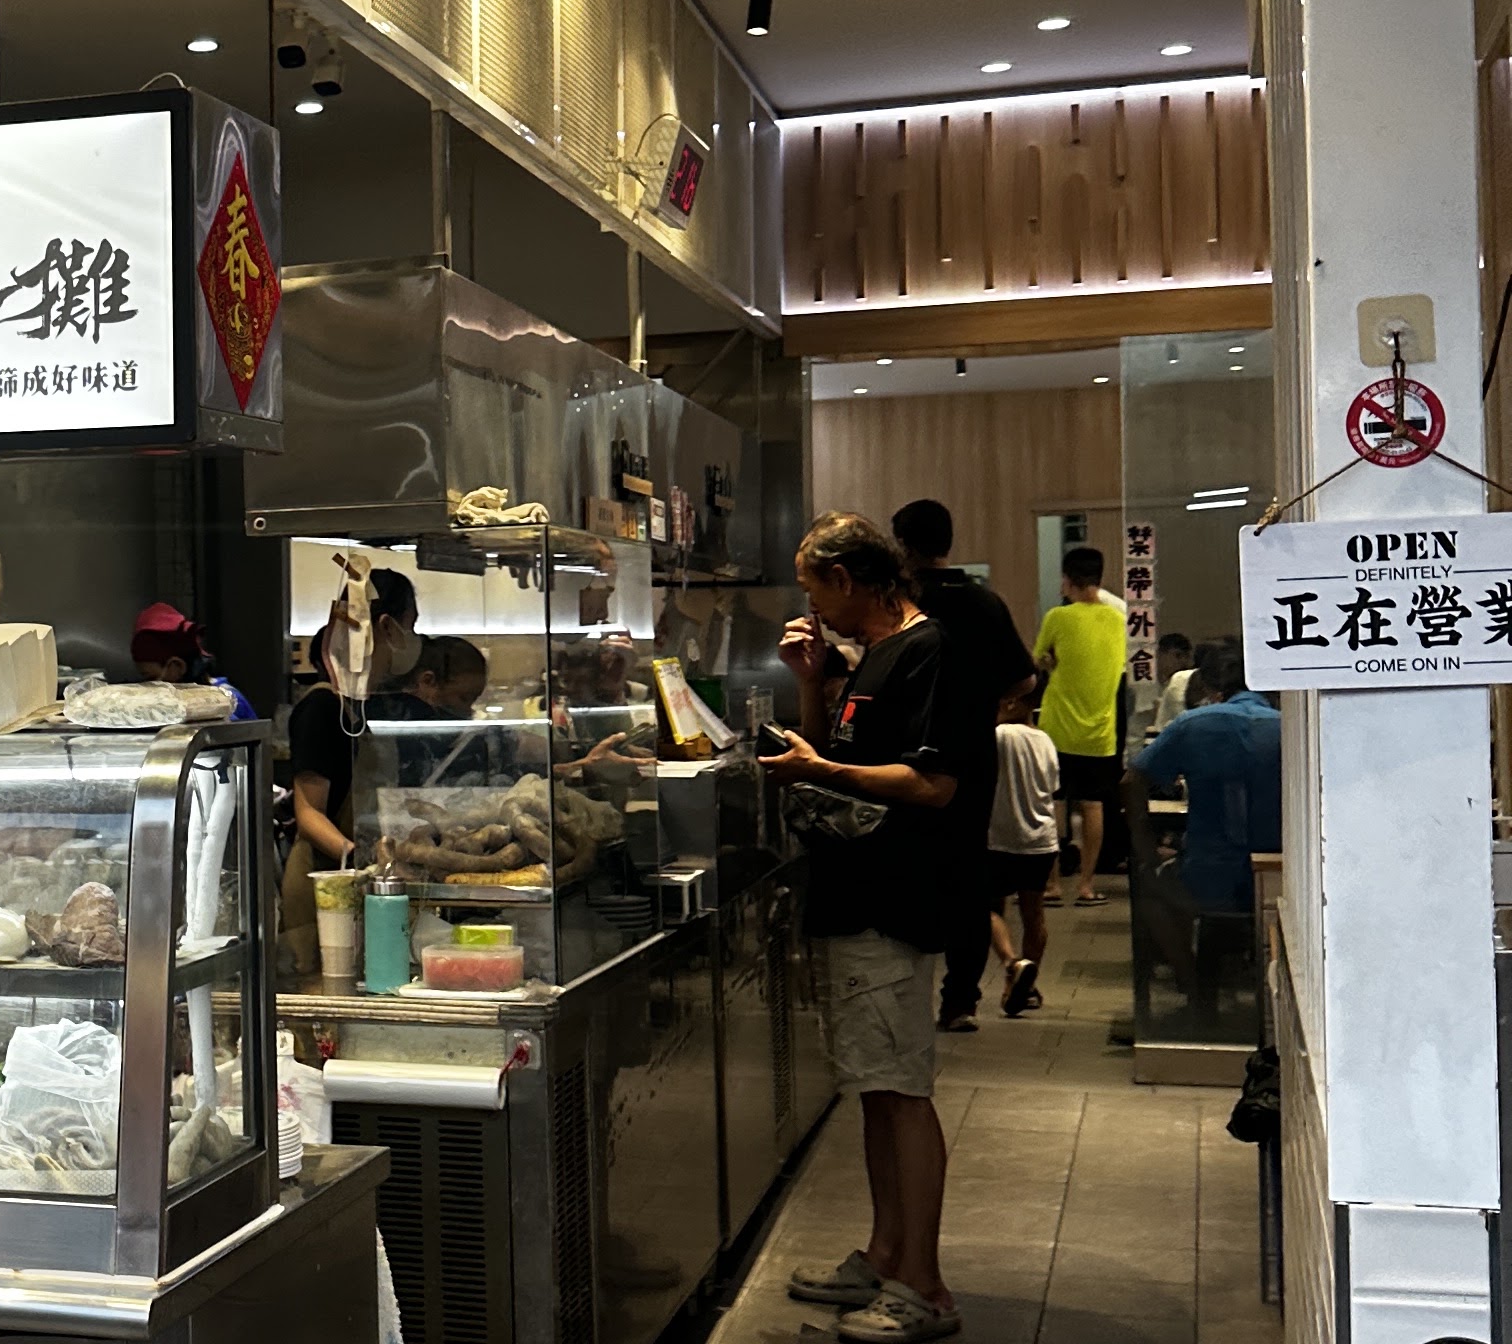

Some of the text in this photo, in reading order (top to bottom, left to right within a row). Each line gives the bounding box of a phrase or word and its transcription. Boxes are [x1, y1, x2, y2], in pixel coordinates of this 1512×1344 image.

[1346, 530, 1458, 563] OPEN
[1355, 565, 1452, 582] DEFINITELY
[1126, 525, 1155, 682] 禁帶外食
[1355, 657, 1461, 673] COME ON IN
